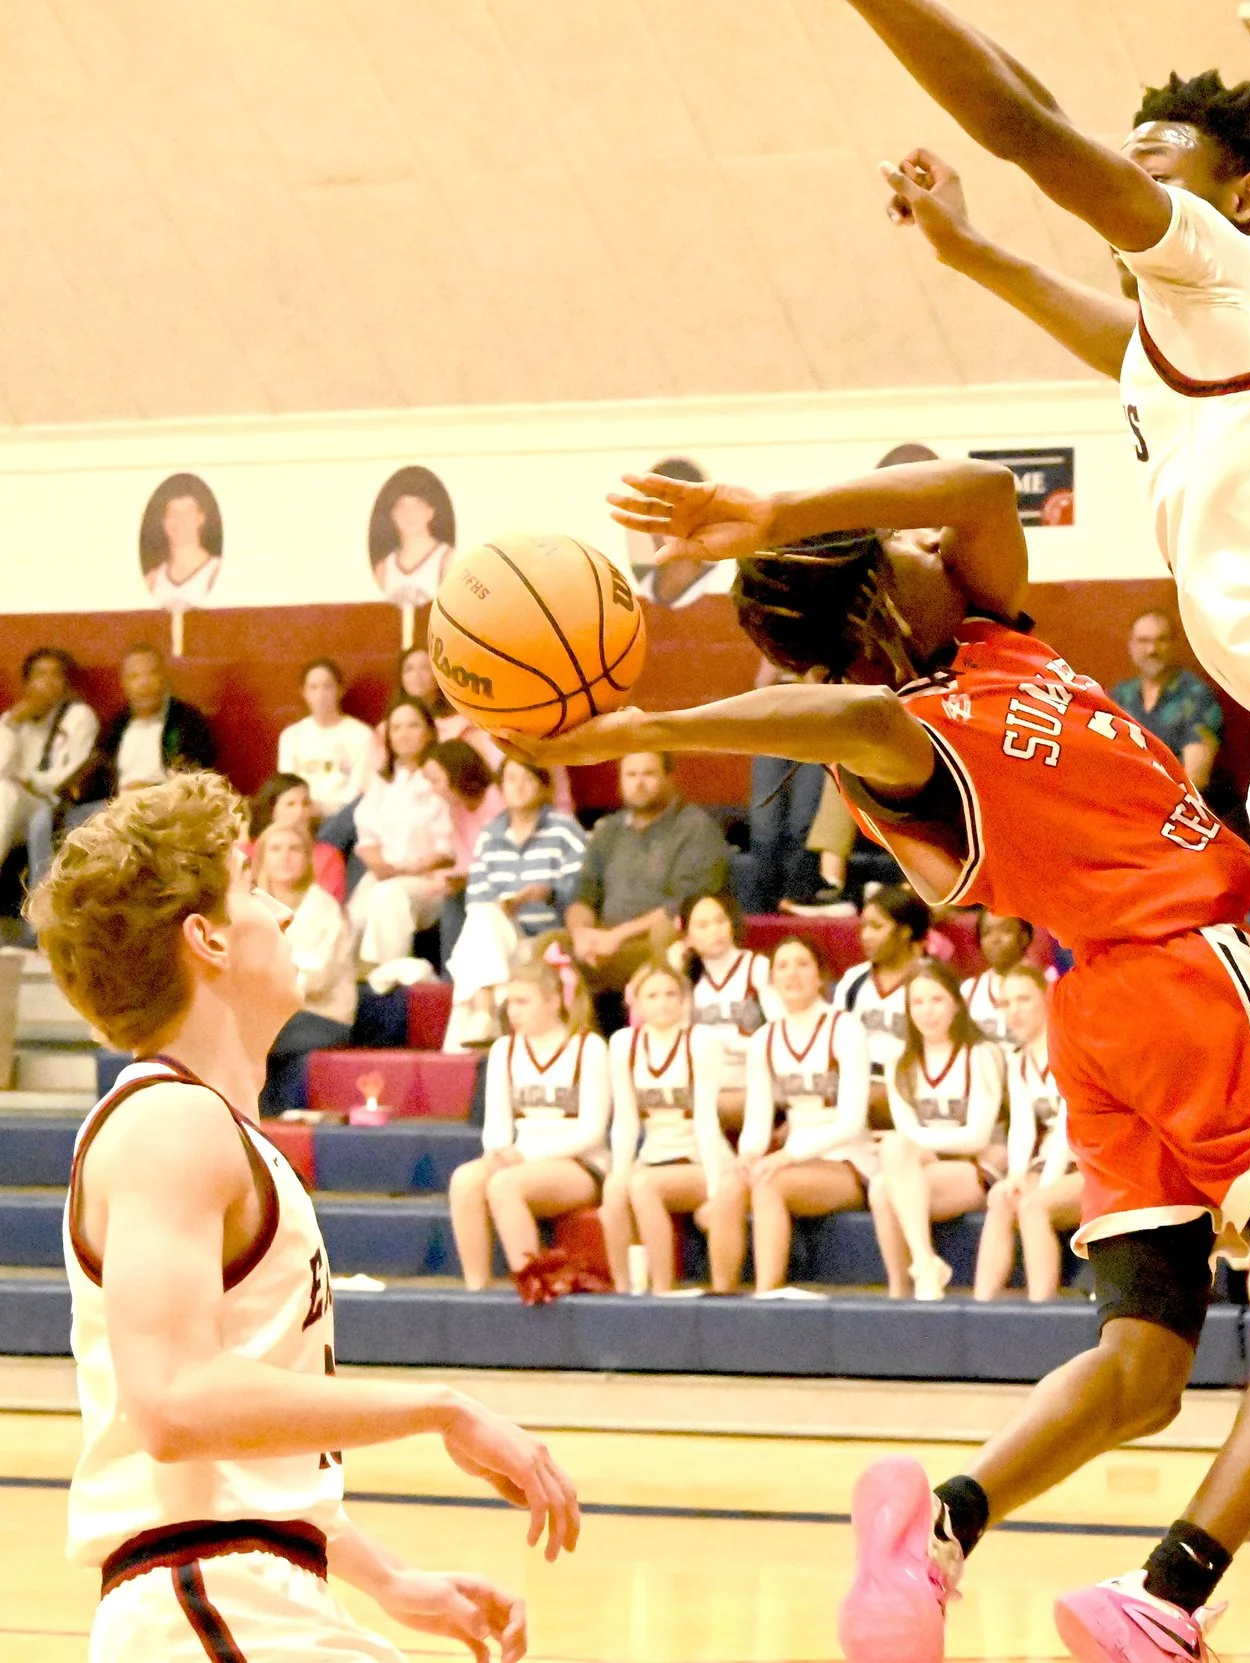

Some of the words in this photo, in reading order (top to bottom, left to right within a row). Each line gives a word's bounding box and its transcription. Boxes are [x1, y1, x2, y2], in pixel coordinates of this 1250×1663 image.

[1123, 404, 1149, 462] S
[1013, 471, 1047, 494] ME
[428, 632, 495, 700] ilson
[302, 1247, 333, 1332] E
